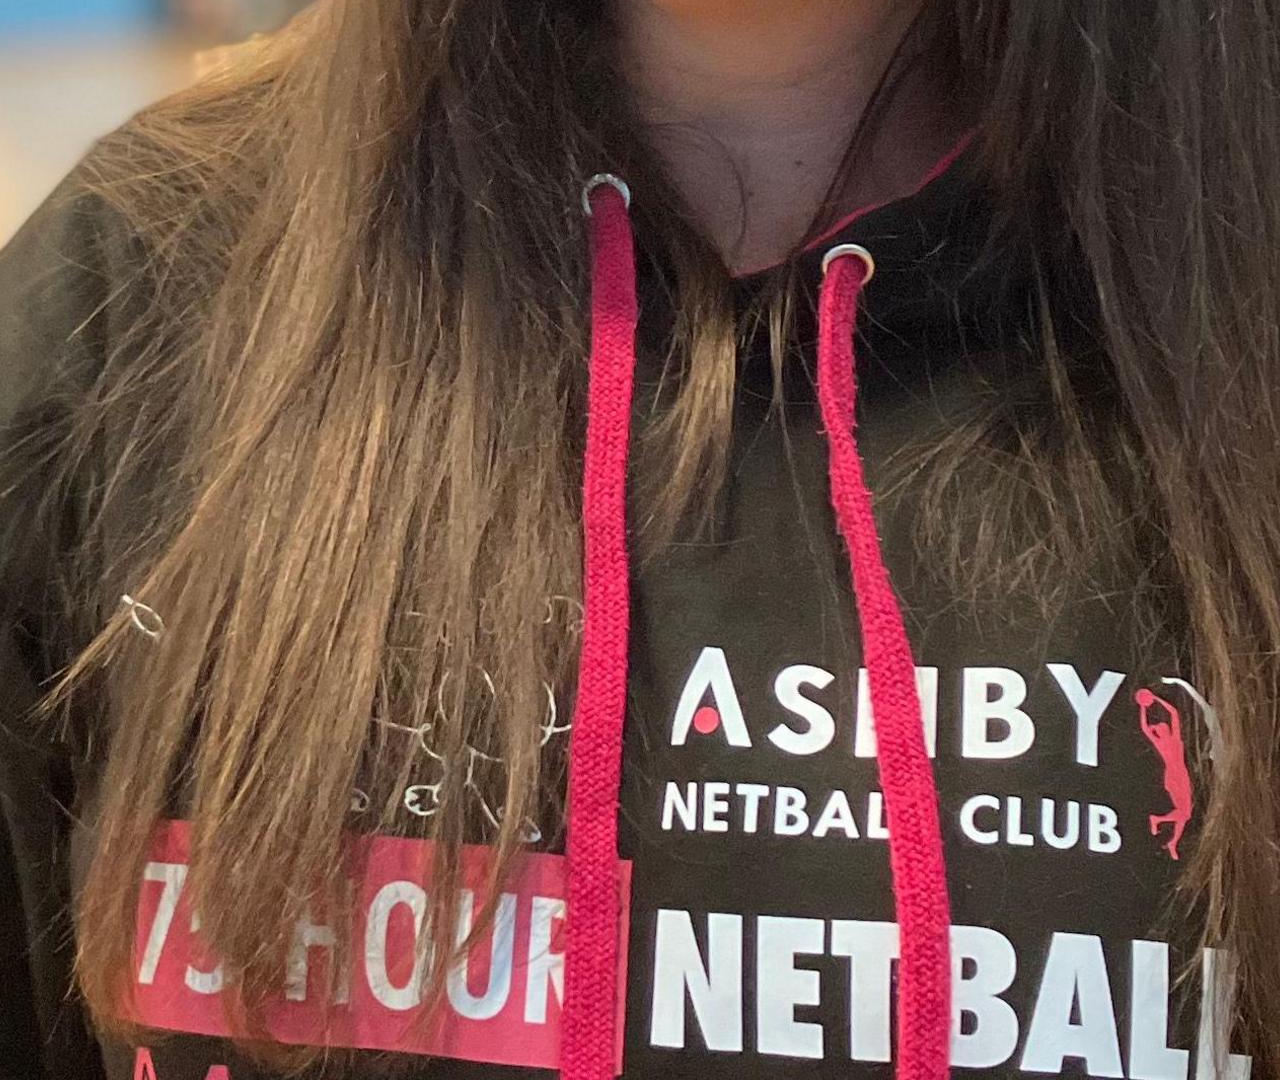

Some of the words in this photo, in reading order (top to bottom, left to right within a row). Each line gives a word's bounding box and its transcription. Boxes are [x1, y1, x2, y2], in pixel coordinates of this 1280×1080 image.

[661, 781, 891, 840] NETBAL
[960, 794, 1122, 854] CLUB
[649, 908, 1253, 1080] NETBALL
